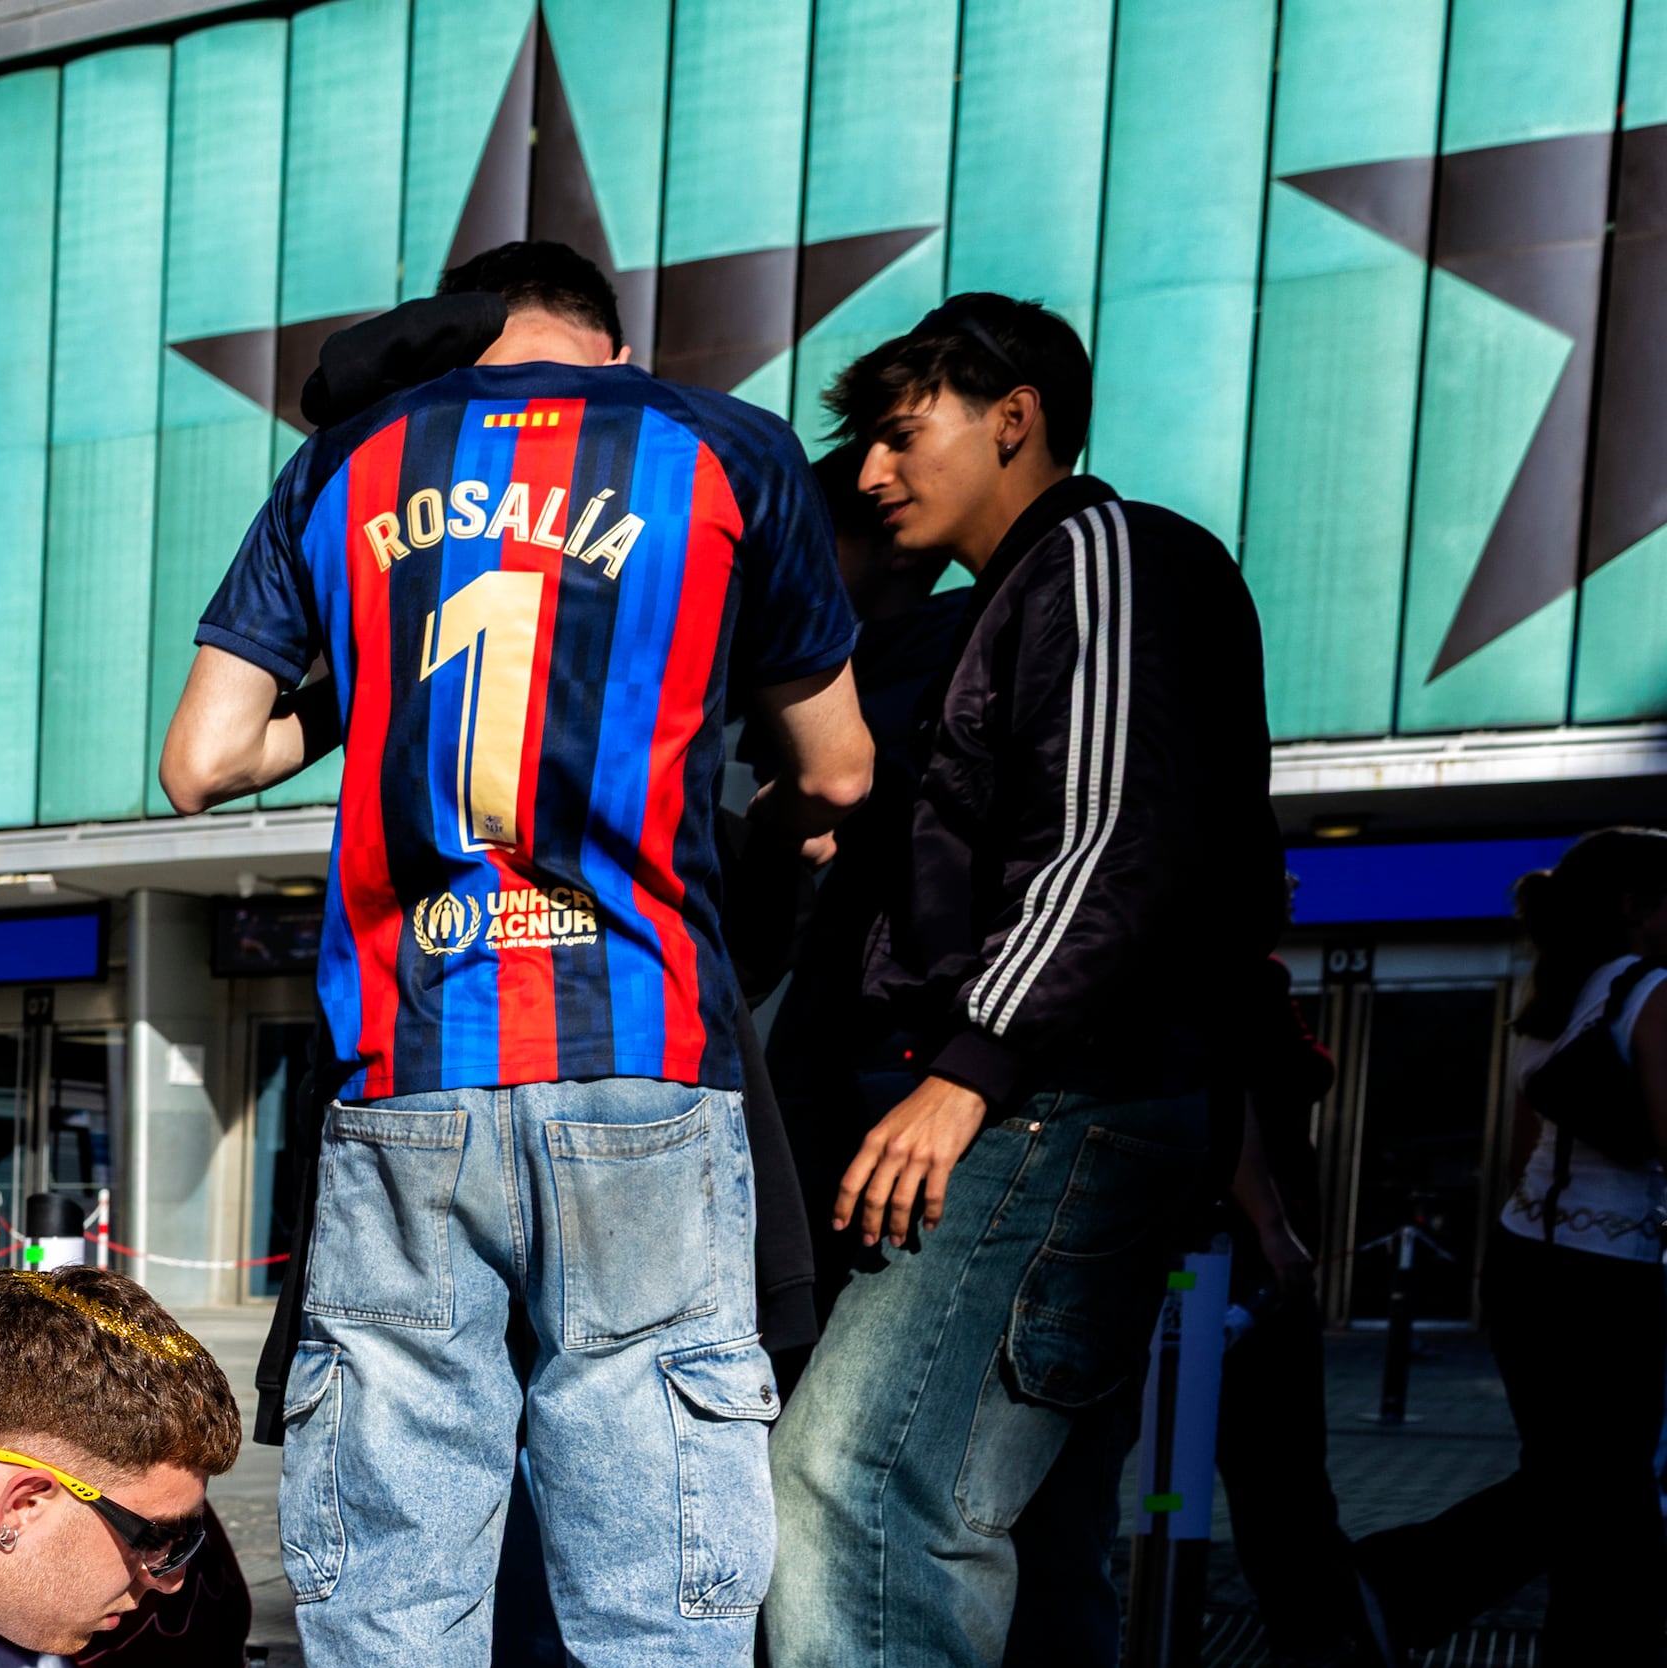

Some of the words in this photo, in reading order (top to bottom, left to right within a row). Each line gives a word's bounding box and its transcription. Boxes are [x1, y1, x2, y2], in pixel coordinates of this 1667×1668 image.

[364, 479, 646, 580] ROSALÍA
[419, 571, 544, 853] 1
[487, 887, 595, 917] UNHCR
[485, 909, 598, 941] ACNUR
[559, 934, 598, 947] Agency
[1329, 949, 1367, 972] 03
[27, 996, 50, 1015] 07
